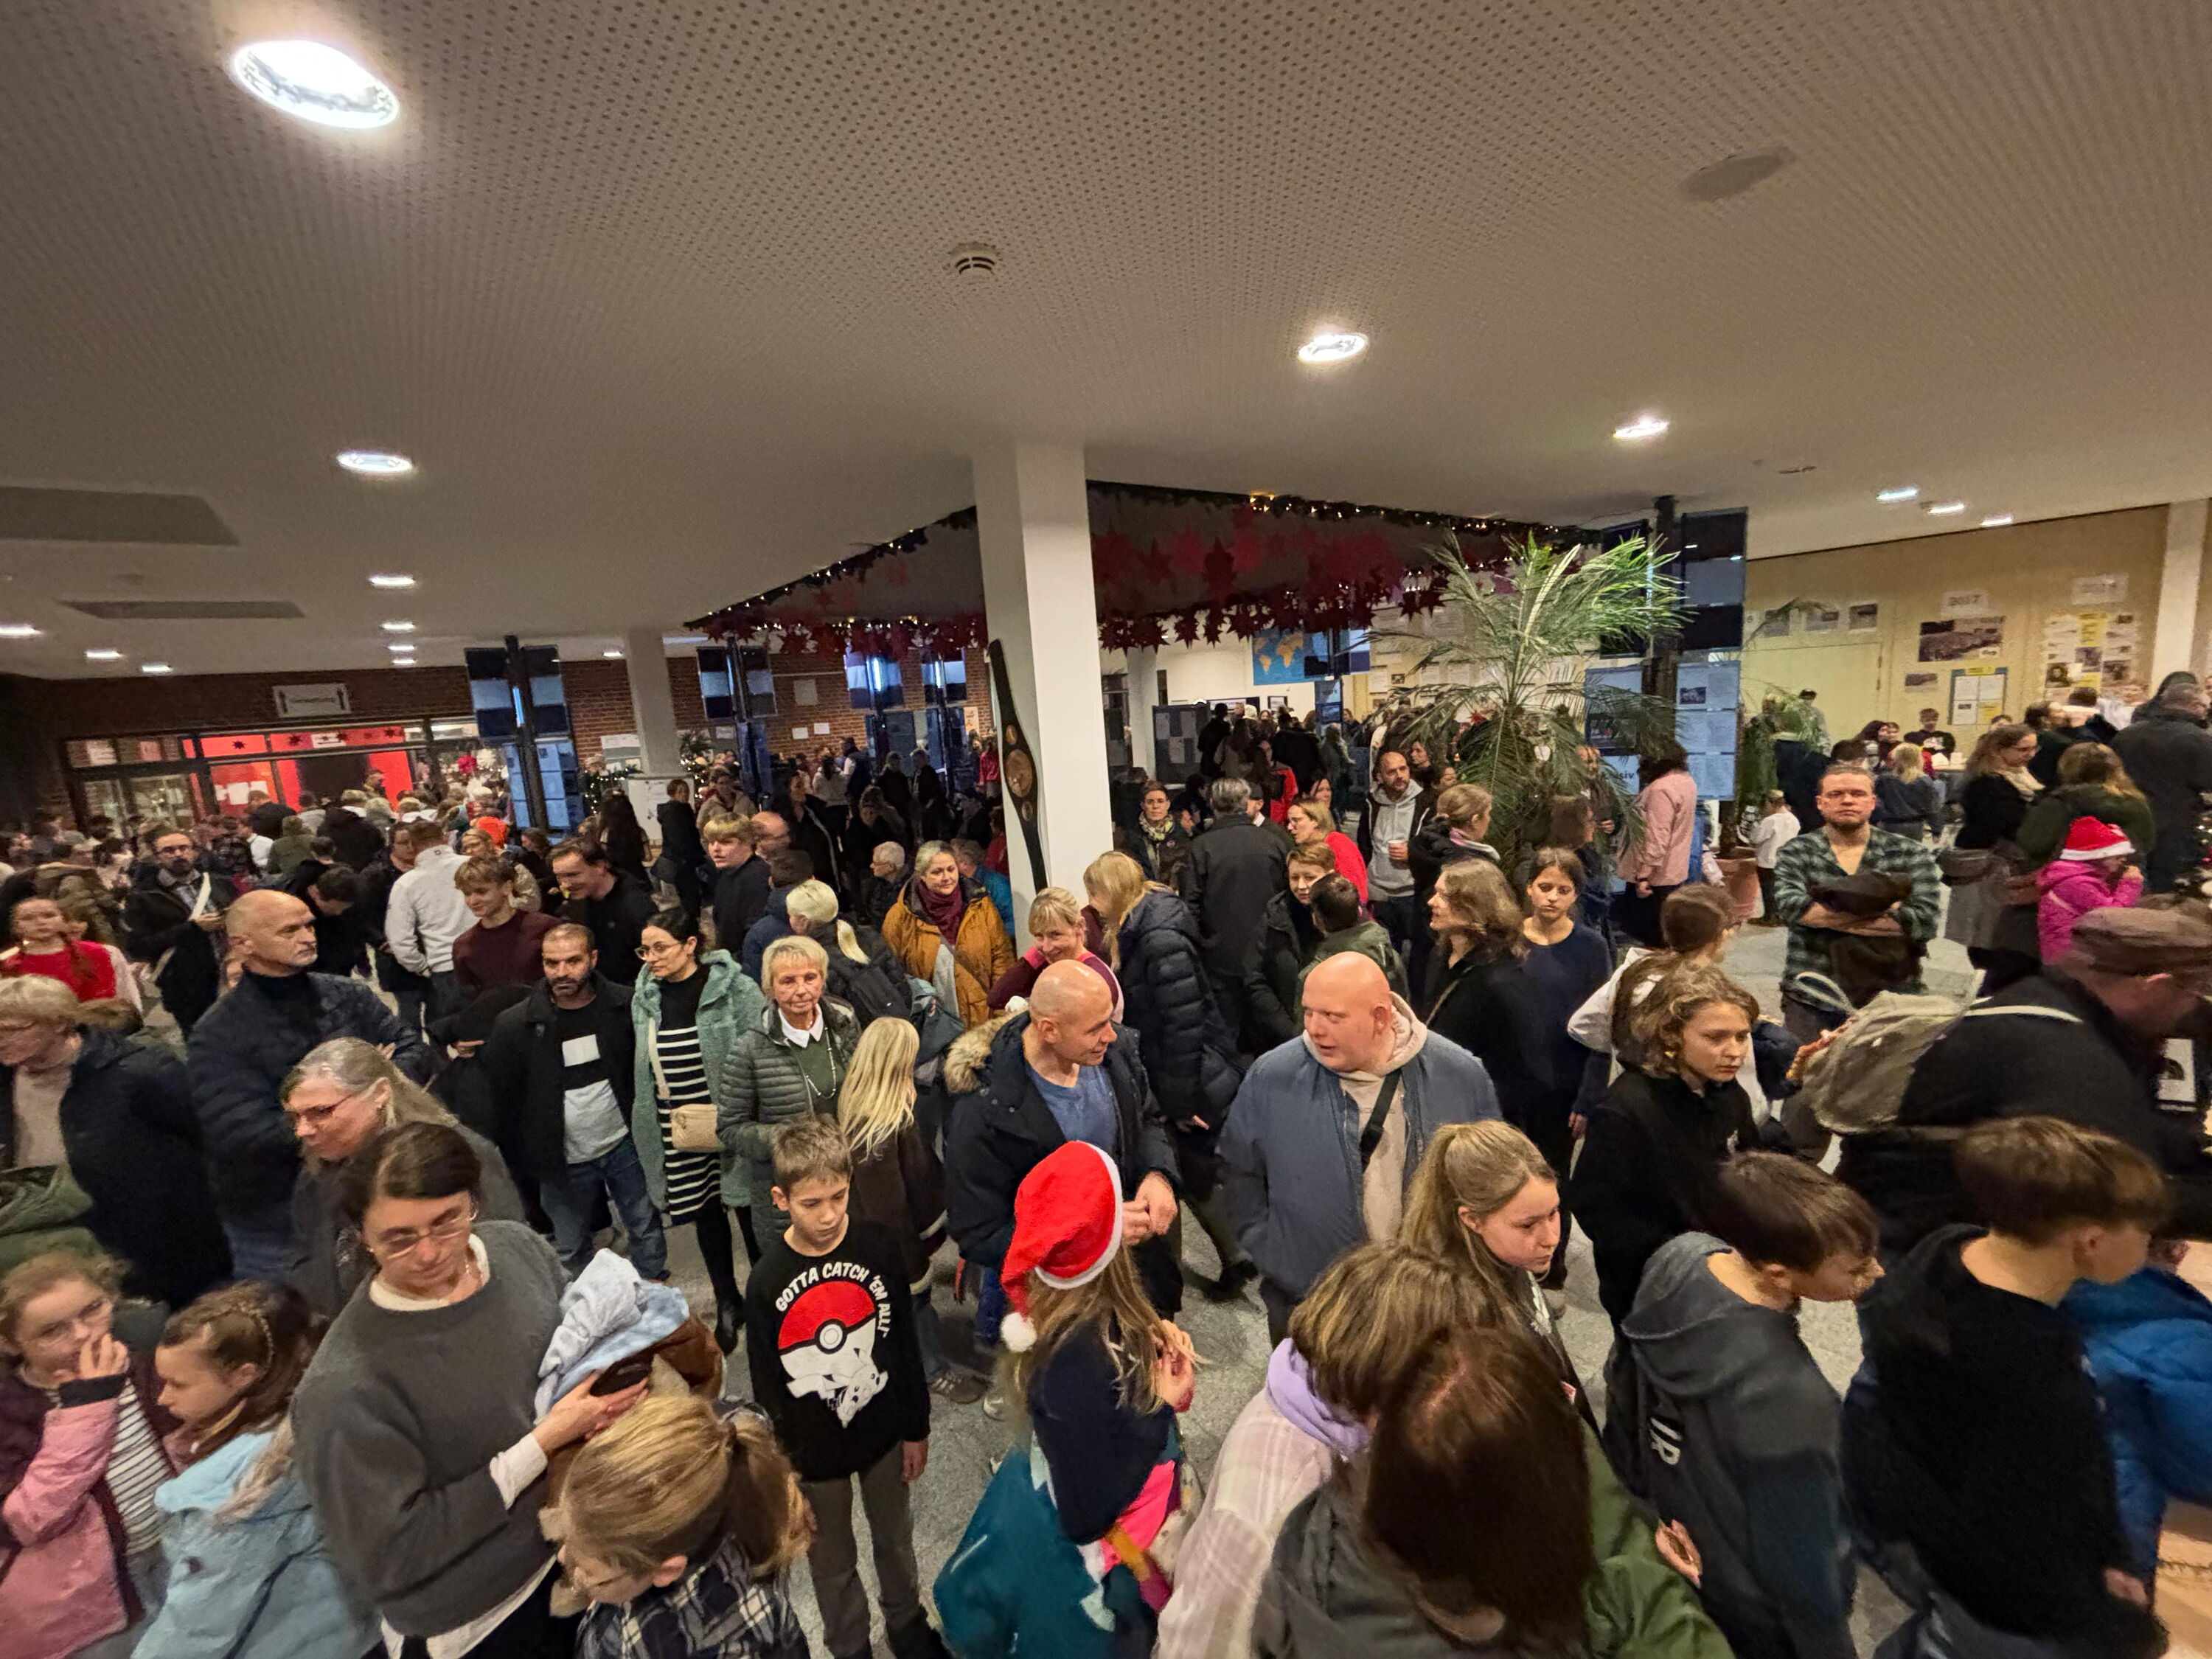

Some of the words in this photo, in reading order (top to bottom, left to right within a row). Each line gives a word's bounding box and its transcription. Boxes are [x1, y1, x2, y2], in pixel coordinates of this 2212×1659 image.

[775, 1267, 819, 1312] GOTTA
[822, 1262, 870, 1282] CATCH
[869, 1275, 888, 1301] 'EM
